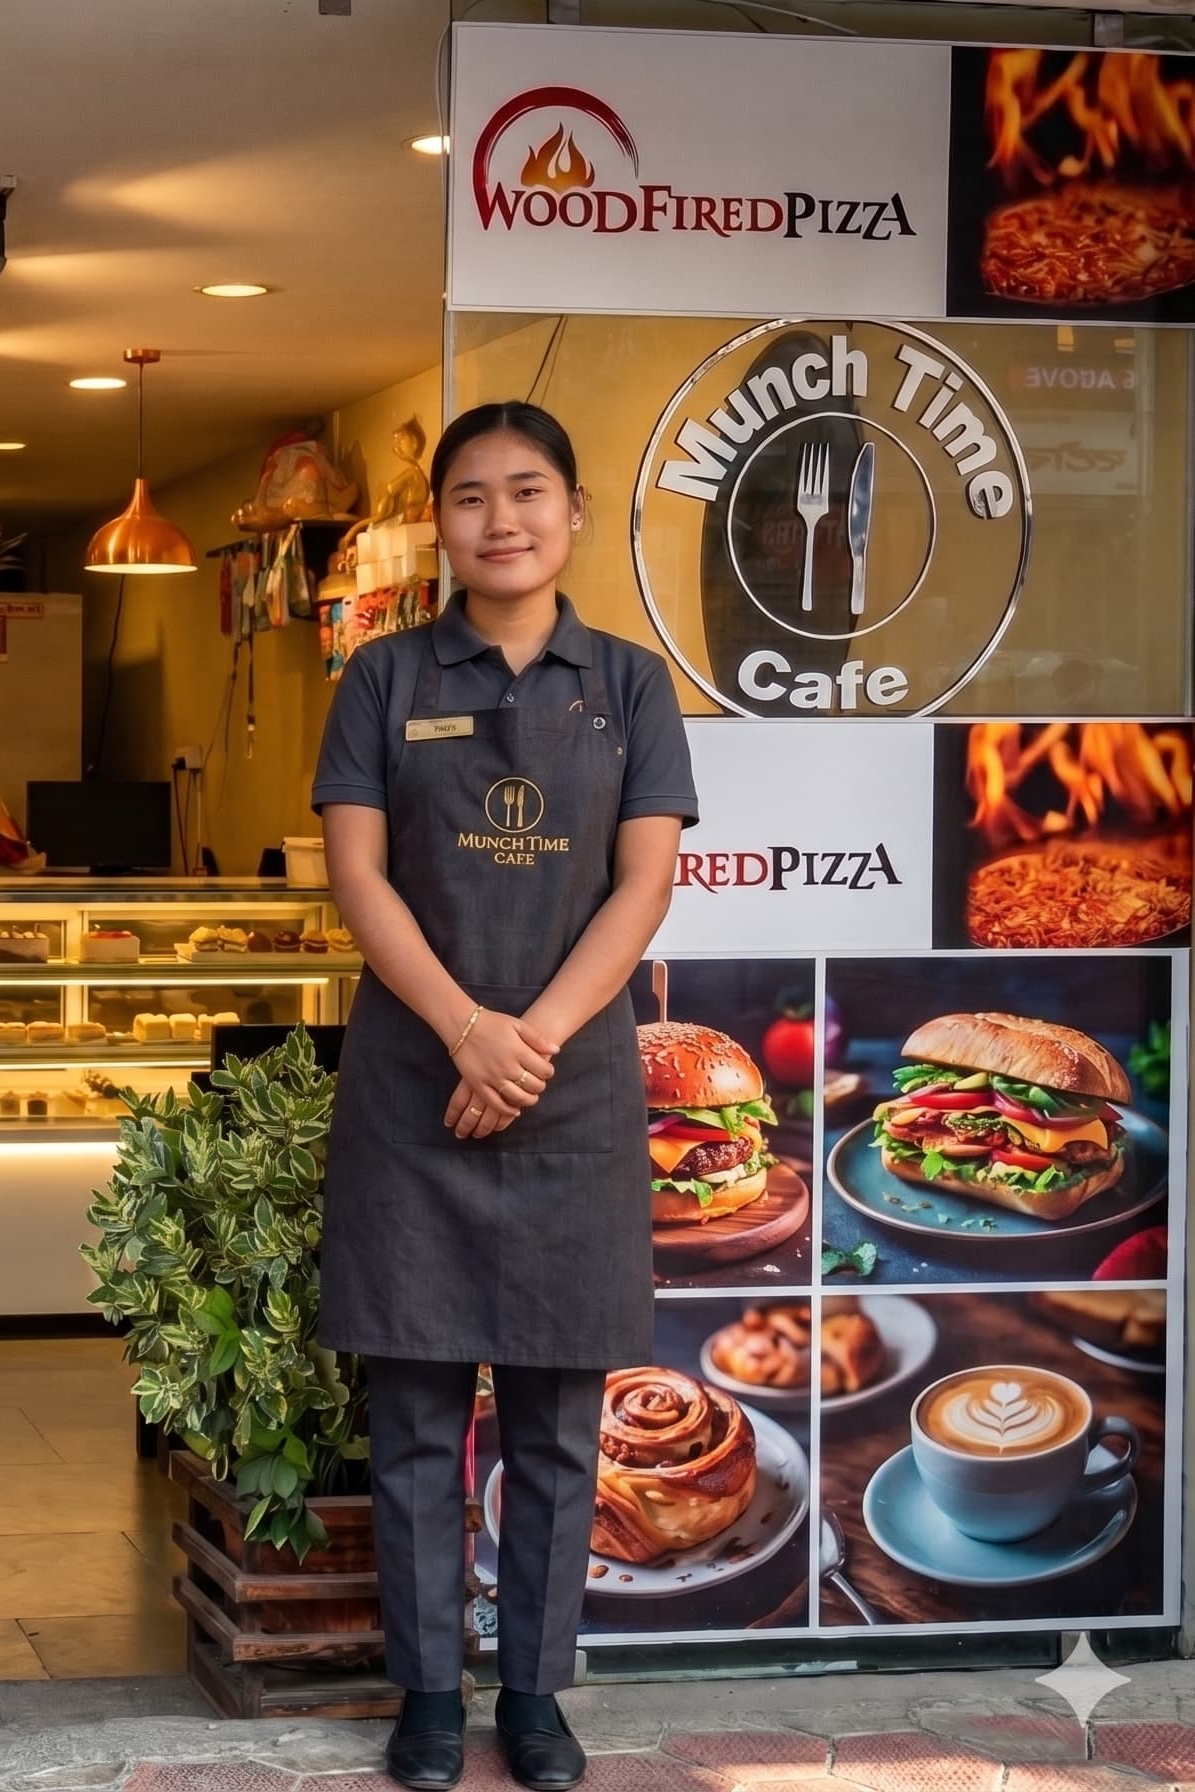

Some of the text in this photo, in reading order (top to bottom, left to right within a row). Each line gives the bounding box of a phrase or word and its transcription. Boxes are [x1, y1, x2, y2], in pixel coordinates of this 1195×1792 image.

[657, 334, 1014, 519] Munch Time
[737, 649, 909, 710] Cafe
[457, 832, 569, 852] MUNCH TIME
[494, 853, 535, 865] CAFE
